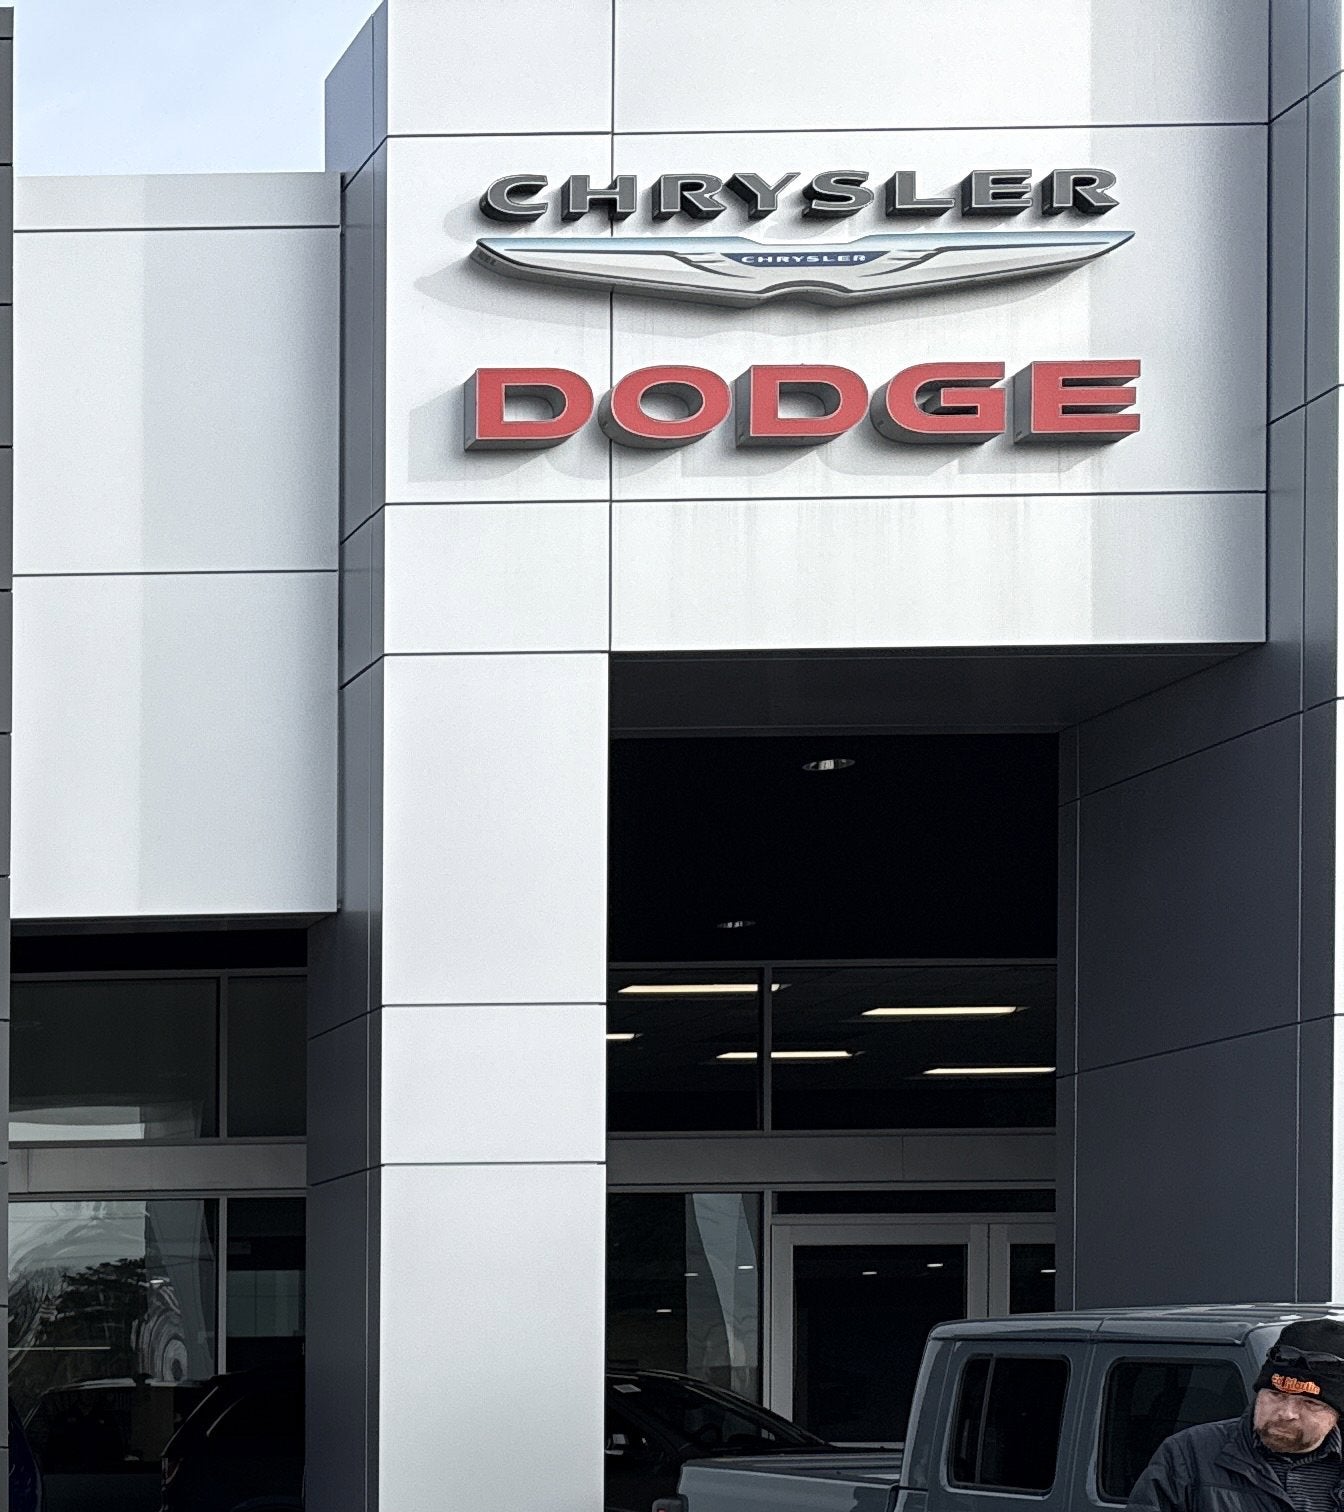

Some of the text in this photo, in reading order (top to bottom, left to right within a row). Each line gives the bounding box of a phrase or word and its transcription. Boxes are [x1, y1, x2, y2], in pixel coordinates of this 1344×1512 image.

[479, 168, 1120, 221] CHRYSLER
[740, 253, 867, 264] CHRYSLER
[464, 359, 1141, 452] DODGE
